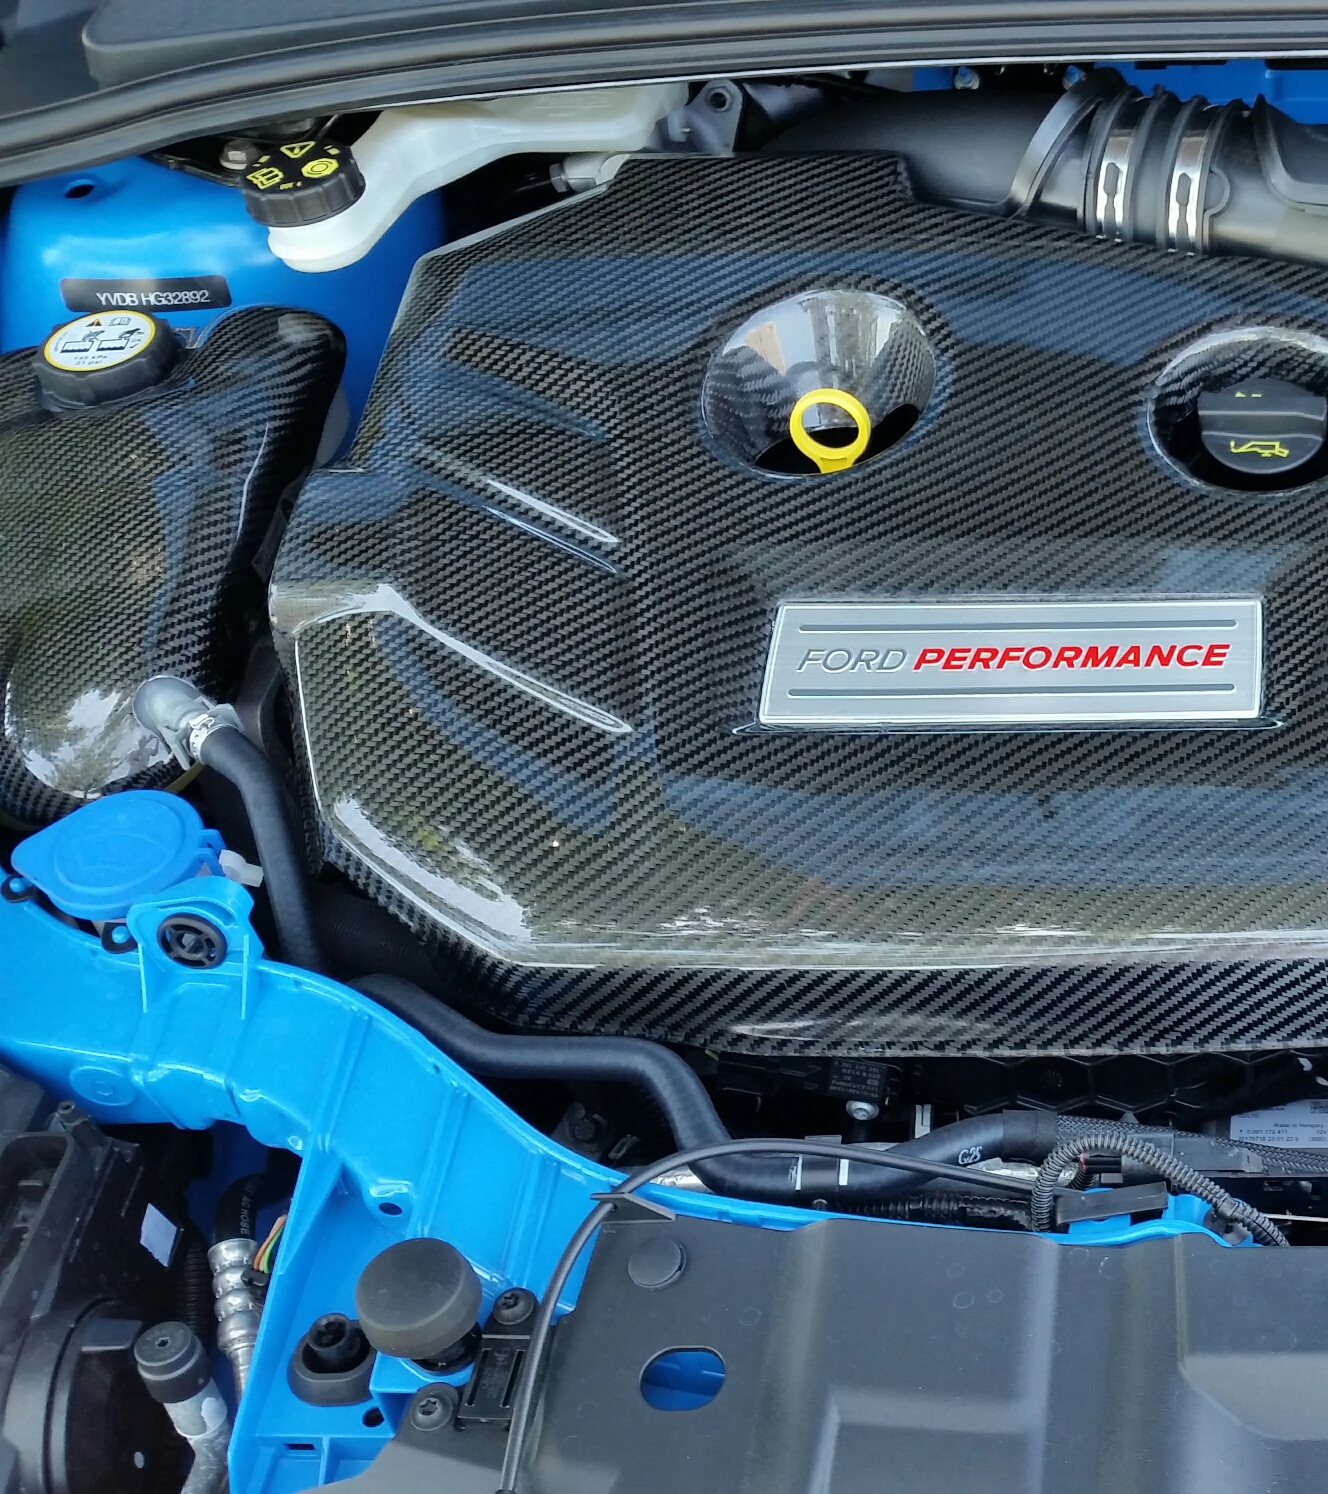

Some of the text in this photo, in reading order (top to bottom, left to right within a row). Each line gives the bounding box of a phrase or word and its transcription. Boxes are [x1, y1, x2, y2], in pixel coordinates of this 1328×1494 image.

[96, 289, 211, 306] YVDB HG32892
[797, 643, 1231, 673] FORD PERFORMANCE
